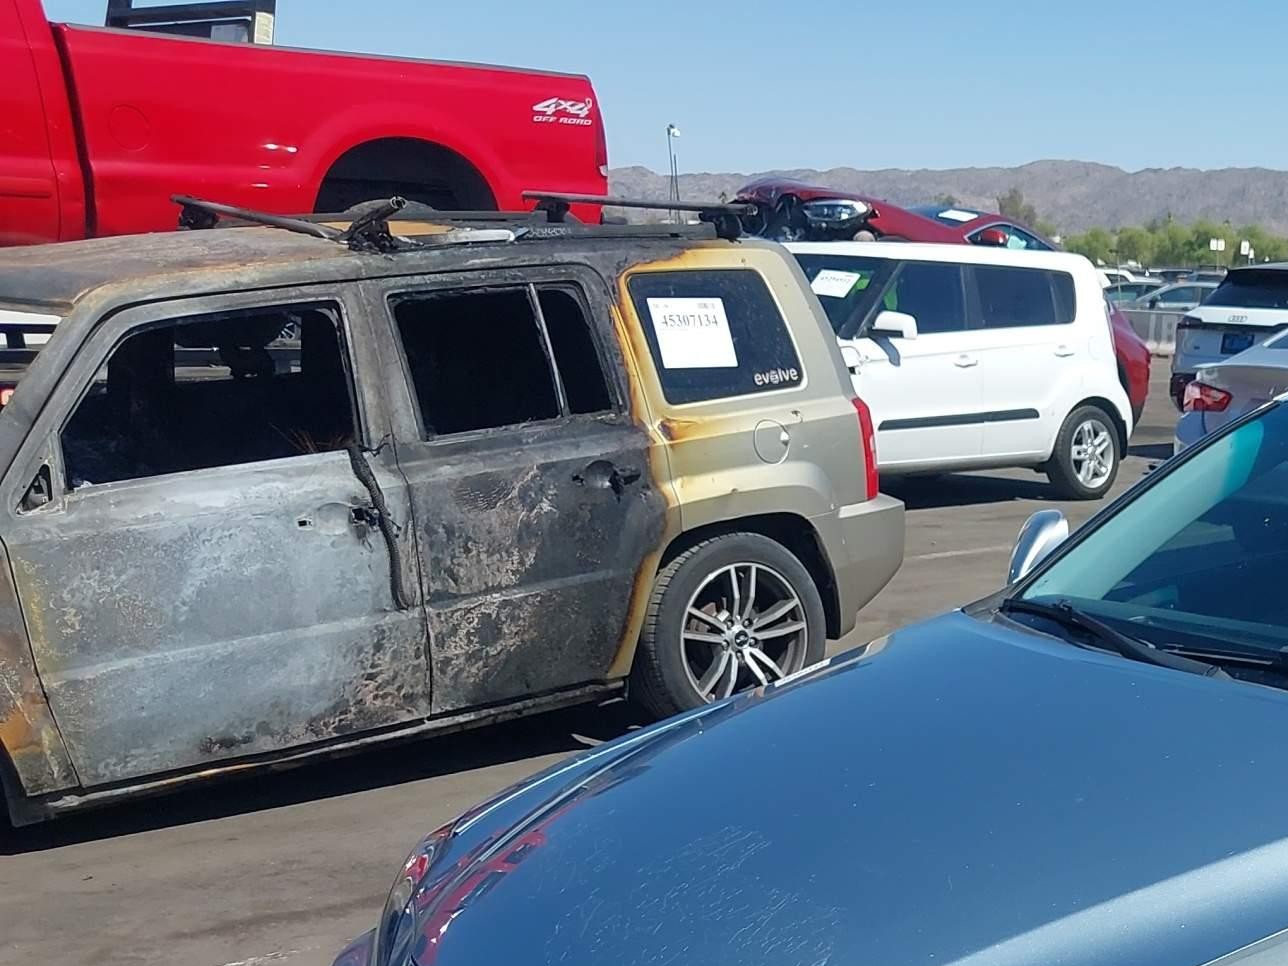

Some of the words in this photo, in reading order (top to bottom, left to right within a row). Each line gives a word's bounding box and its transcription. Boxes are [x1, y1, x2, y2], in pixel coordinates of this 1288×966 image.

[559, 117, 592, 126] ROAD
[661, 313, 719, 328] 45307134
[754, 367, 799, 386] evolve
